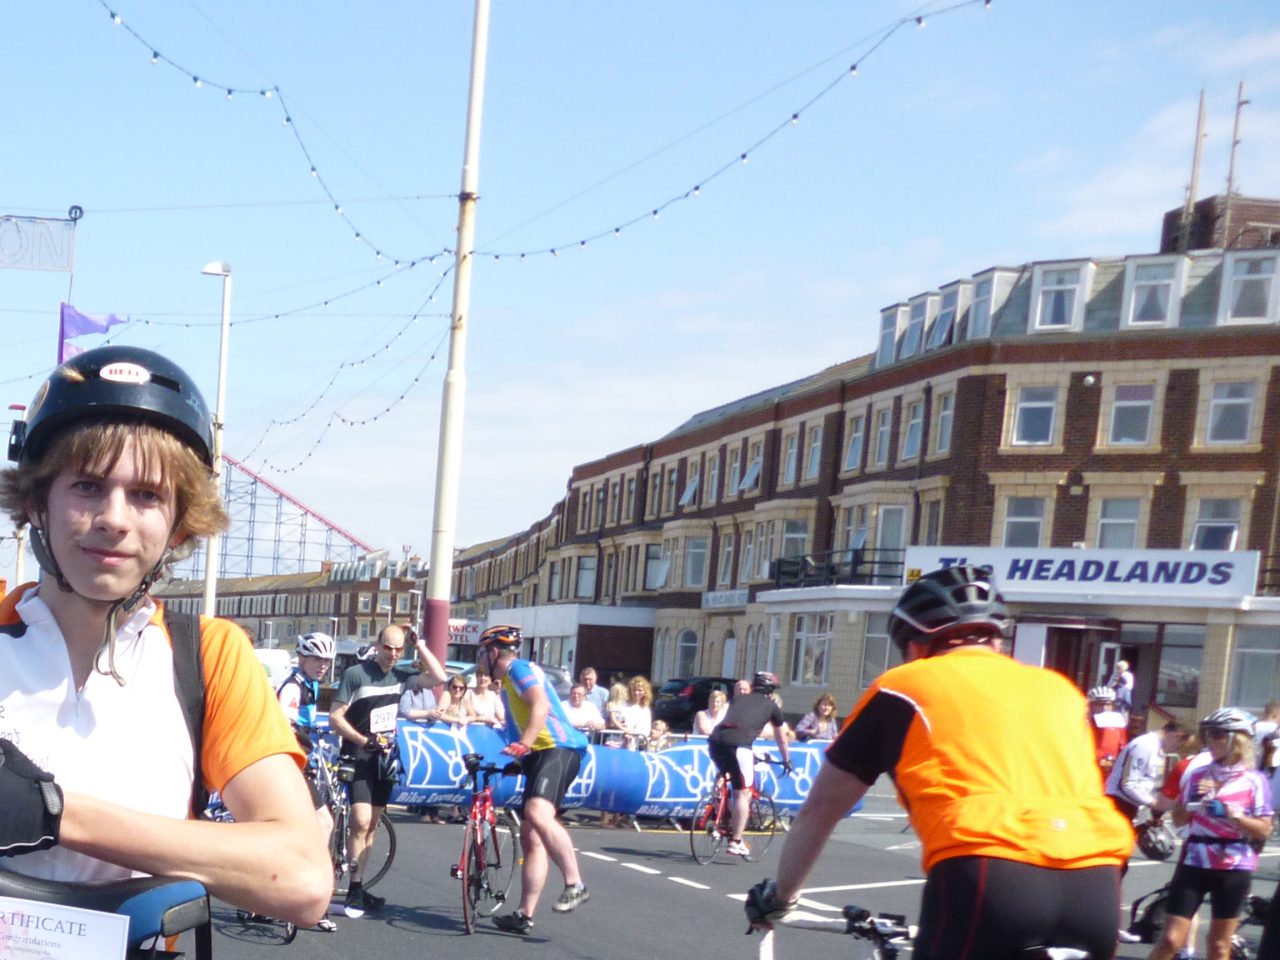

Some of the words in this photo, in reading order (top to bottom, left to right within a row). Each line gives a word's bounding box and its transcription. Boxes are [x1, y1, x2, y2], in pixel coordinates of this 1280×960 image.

[1006, 558, 1235, 586] HEADLANDS
[395, 791, 426, 803] Bike
[635, 804, 669, 816] Bike
